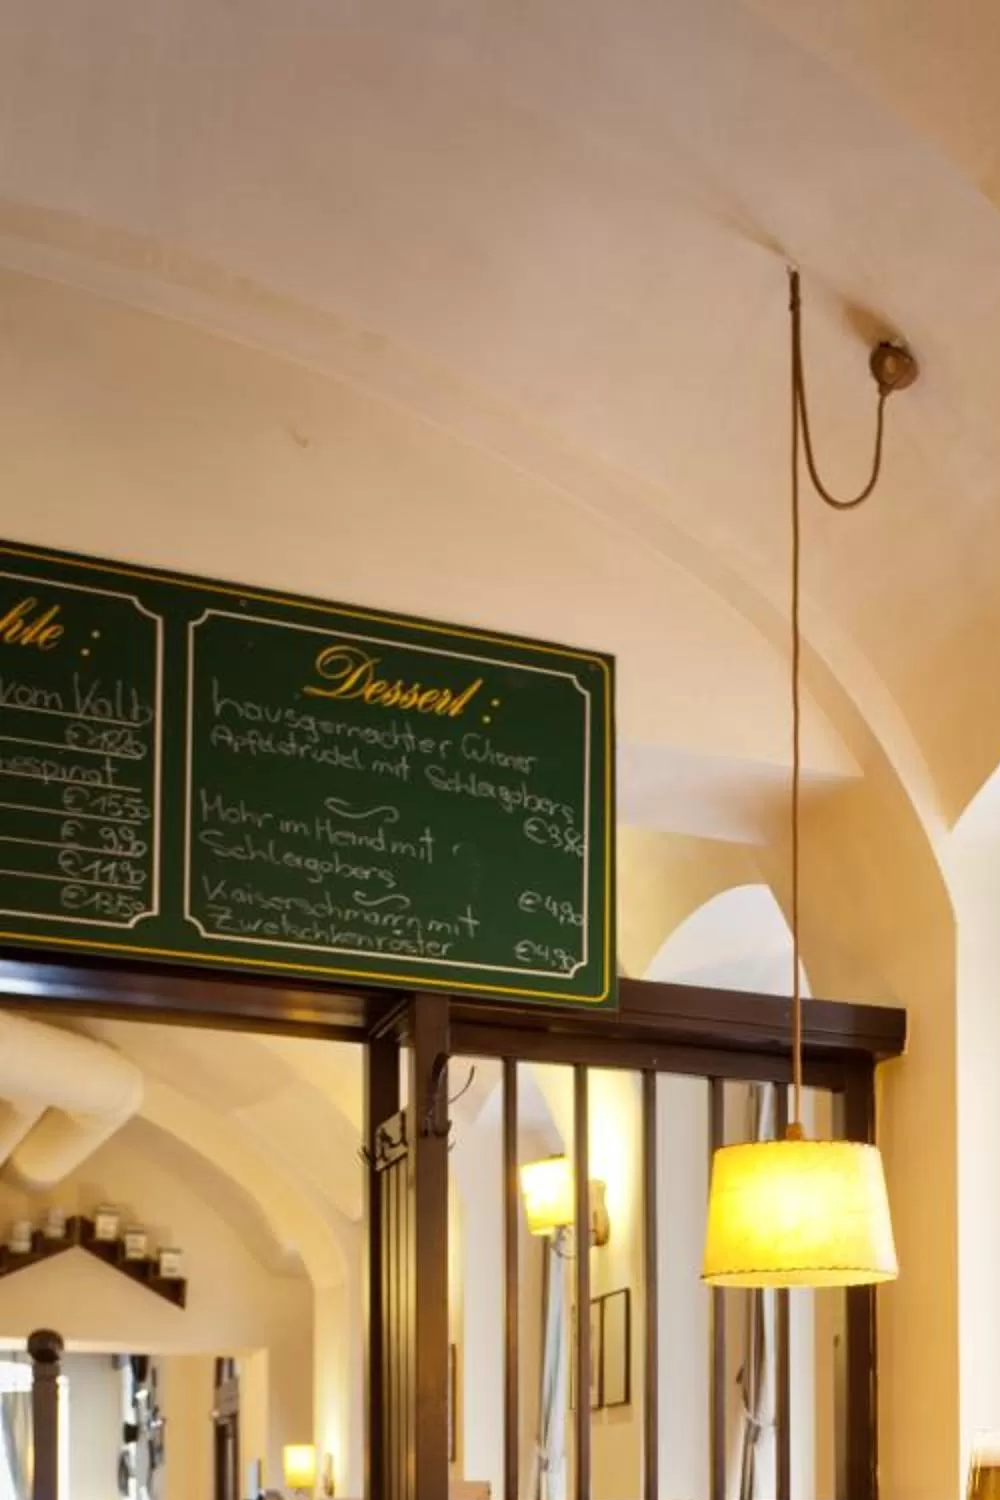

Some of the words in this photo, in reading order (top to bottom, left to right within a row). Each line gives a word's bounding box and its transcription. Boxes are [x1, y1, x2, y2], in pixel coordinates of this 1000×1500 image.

[303, 645, 484, 717] Dessert
[371, 755, 412, 781] mit
[199, 829, 397, 889] Schlagobers
[390, 826, 436, 864] mit
[427, 904, 482, 940] mit
